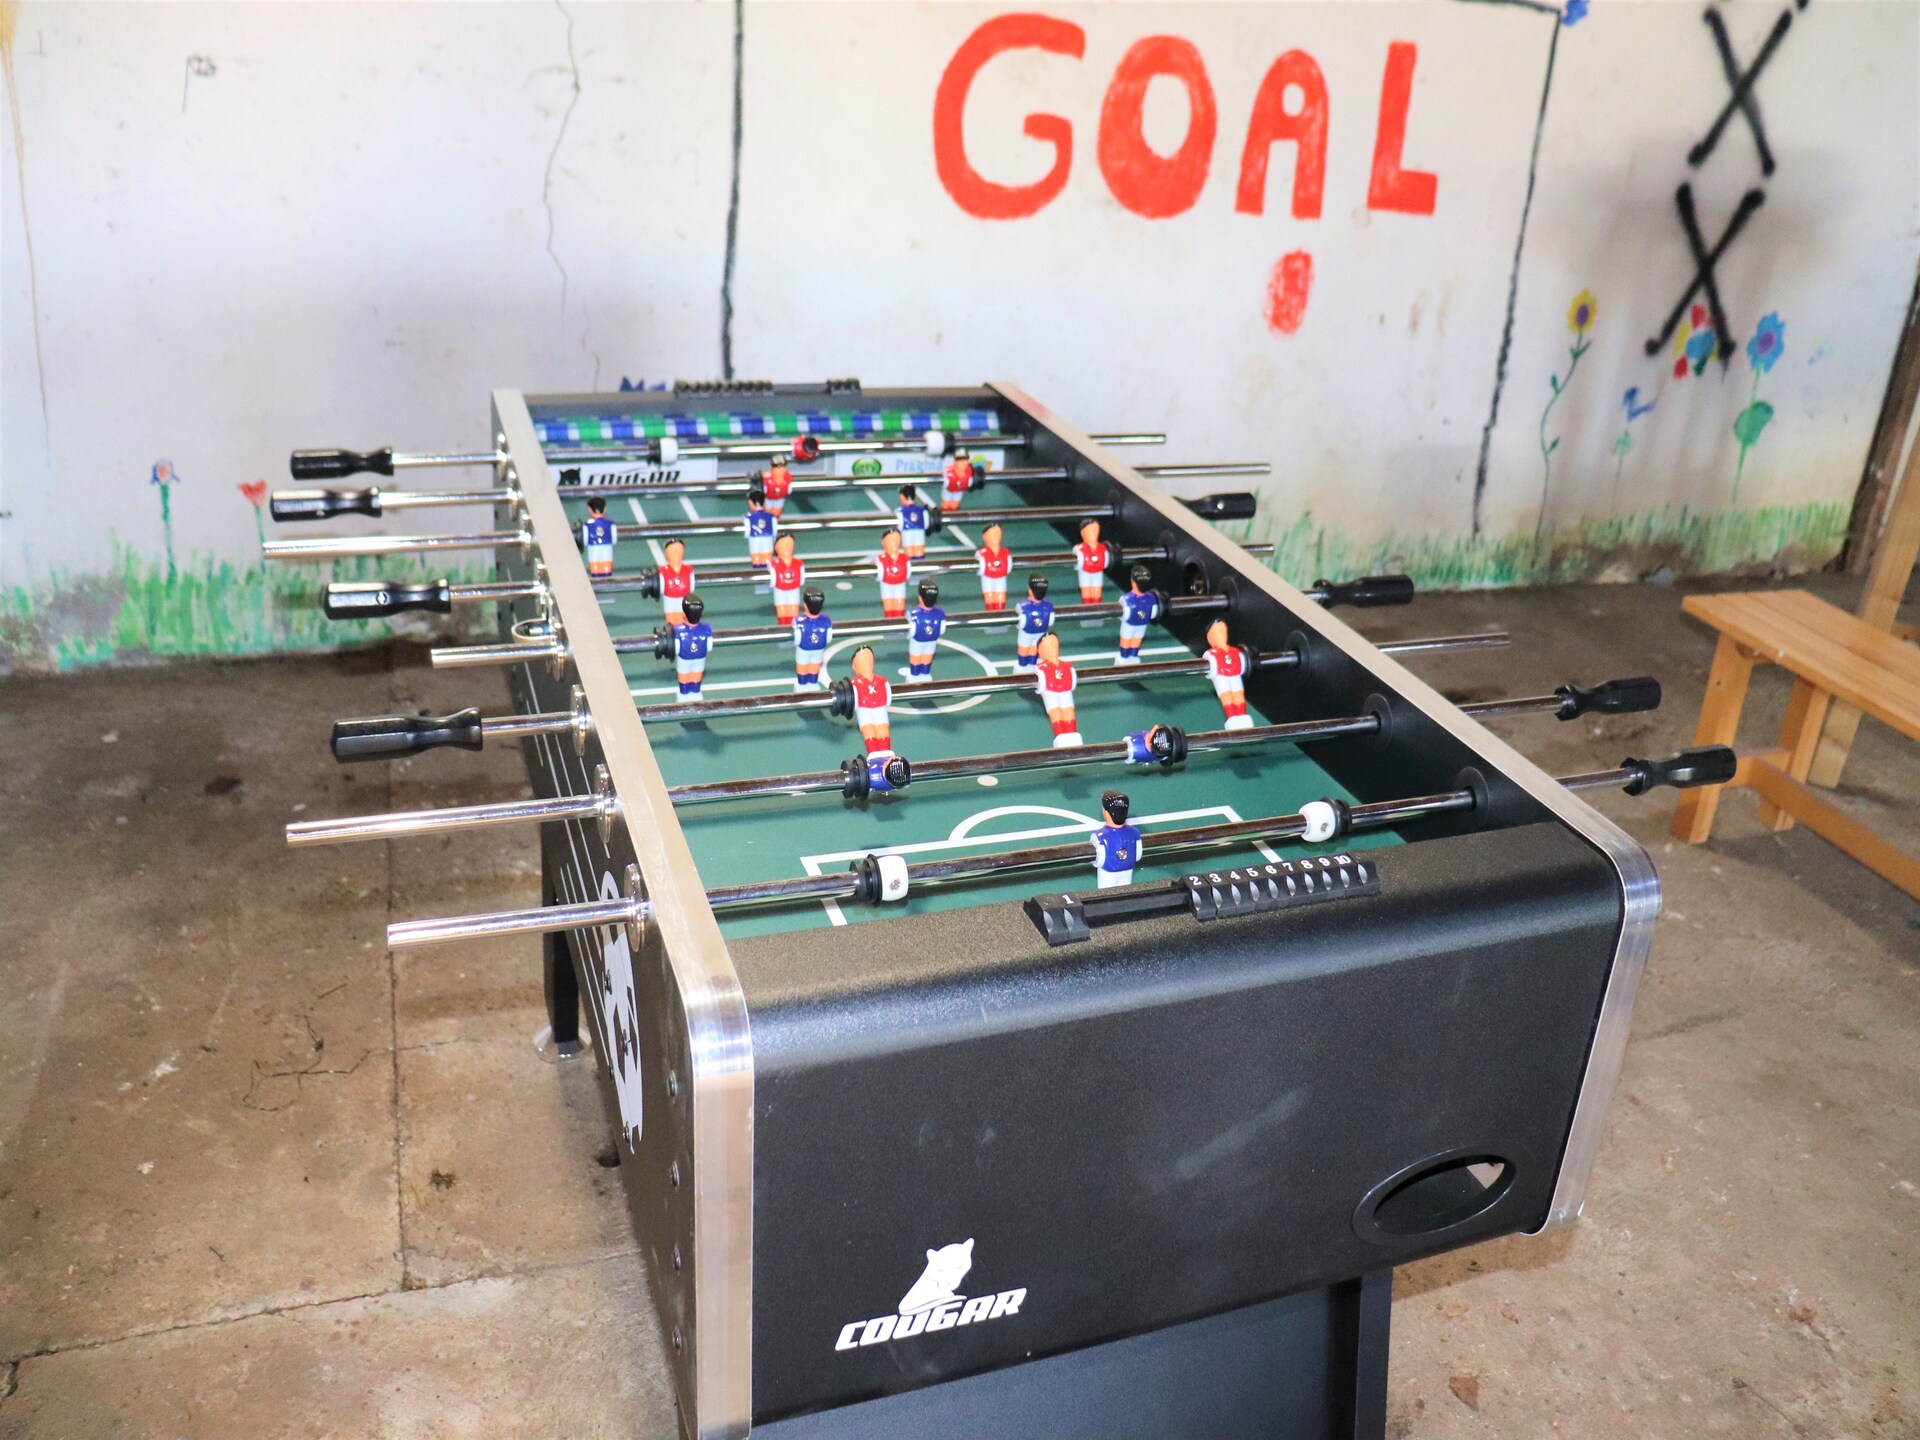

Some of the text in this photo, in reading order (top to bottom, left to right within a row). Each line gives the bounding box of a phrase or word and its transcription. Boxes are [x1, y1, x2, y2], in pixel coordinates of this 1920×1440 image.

[933, 13, 1438, 220] GOAL
[1061, 854, 1352, 905] 1 2 3 4 5 6 7 8 9 10
[835, 1287, 1027, 1351] COUGAR
